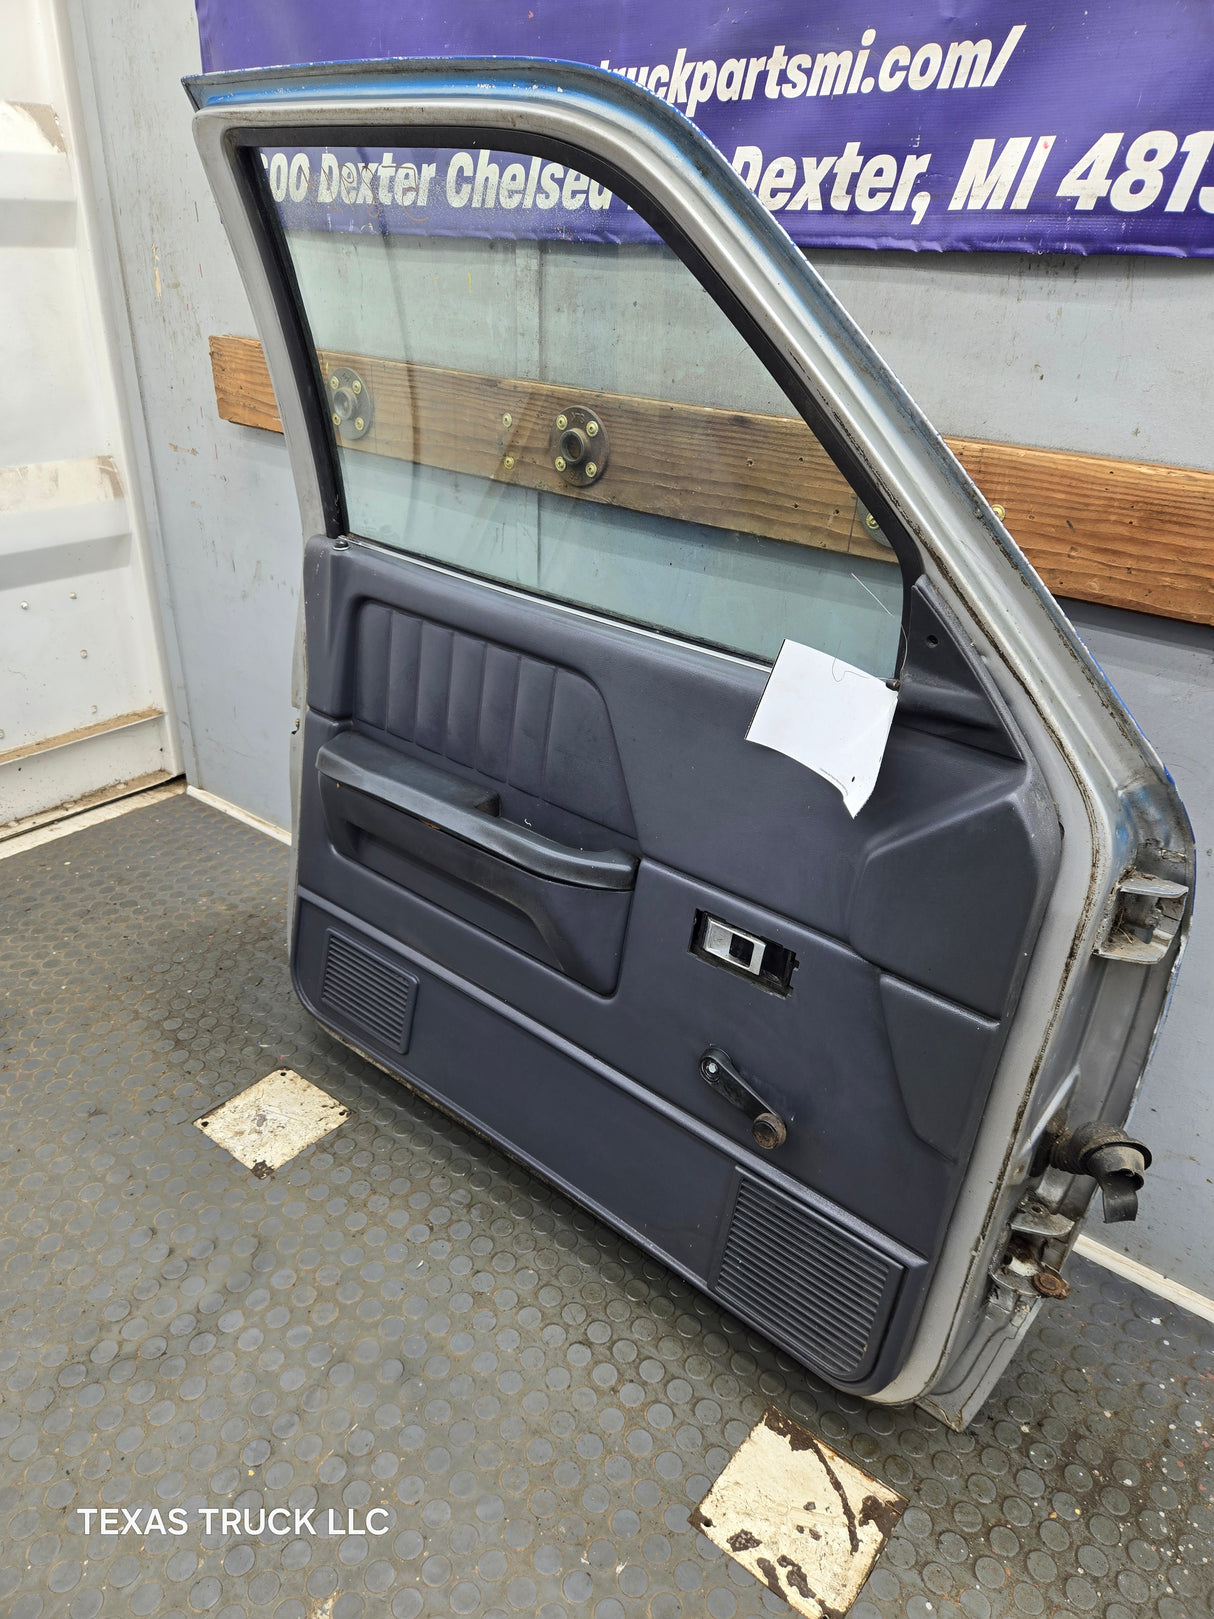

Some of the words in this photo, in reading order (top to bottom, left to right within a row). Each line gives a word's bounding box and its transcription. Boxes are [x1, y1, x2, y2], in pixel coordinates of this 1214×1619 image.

[600, 24, 1027, 118] ckpartsmi.com/
[317, 152, 437, 207] Dexter
[731, 141, 932, 225] Dexter,
[947, 134, 1057, 211] MI
[1055, 130, 1214, 214] 481
